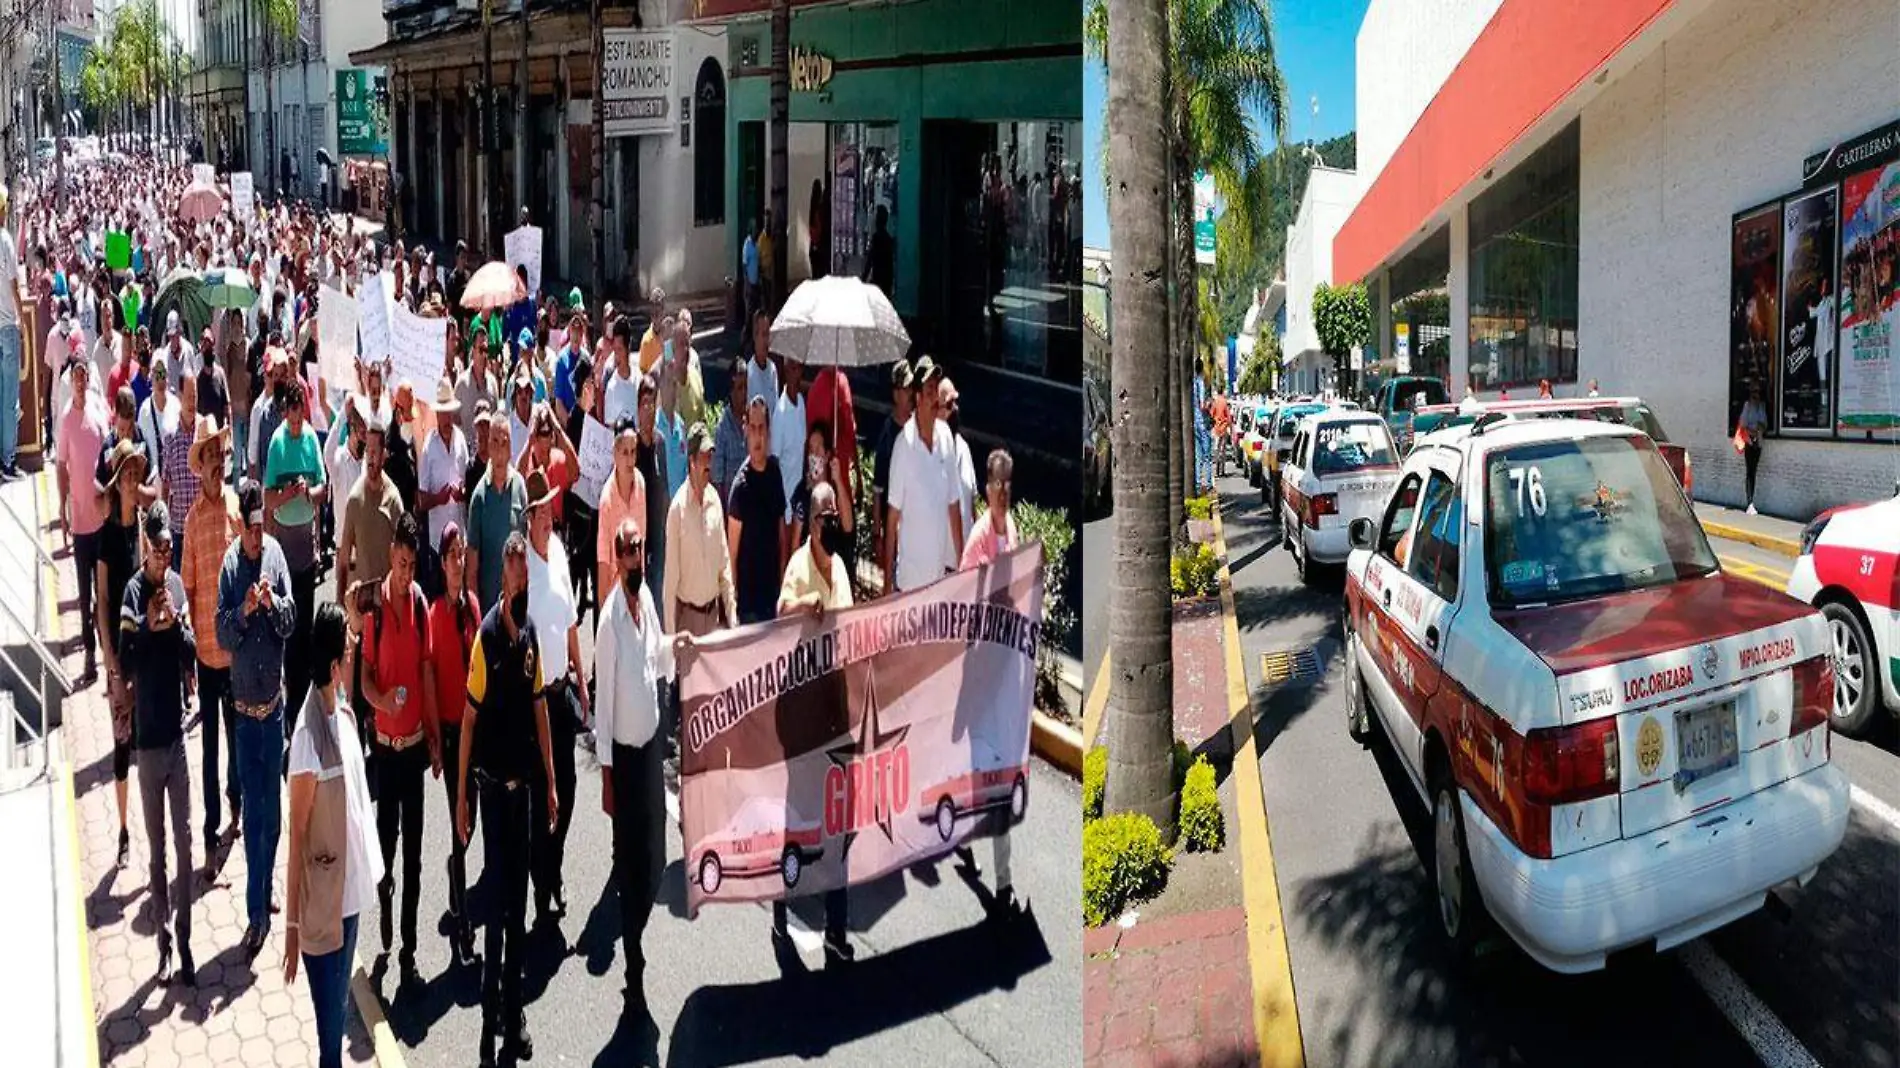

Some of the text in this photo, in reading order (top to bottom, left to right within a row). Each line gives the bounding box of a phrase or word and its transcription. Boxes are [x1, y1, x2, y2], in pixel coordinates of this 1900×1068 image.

[605, 40, 671, 61] ESTAURANTE
[1837, 132, 1892, 169] CARTELERAS
[1509, 466, 1547, 518] 76
[1860, 554, 1875, 576] 37
[689, 637, 818, 752] ORGANIZACIÓN
[922, 601, 1040, 661] INDEPENDIENTES
[824, 744, 910, 836] GRITO
[1490, 734, 1505, 803] 76
